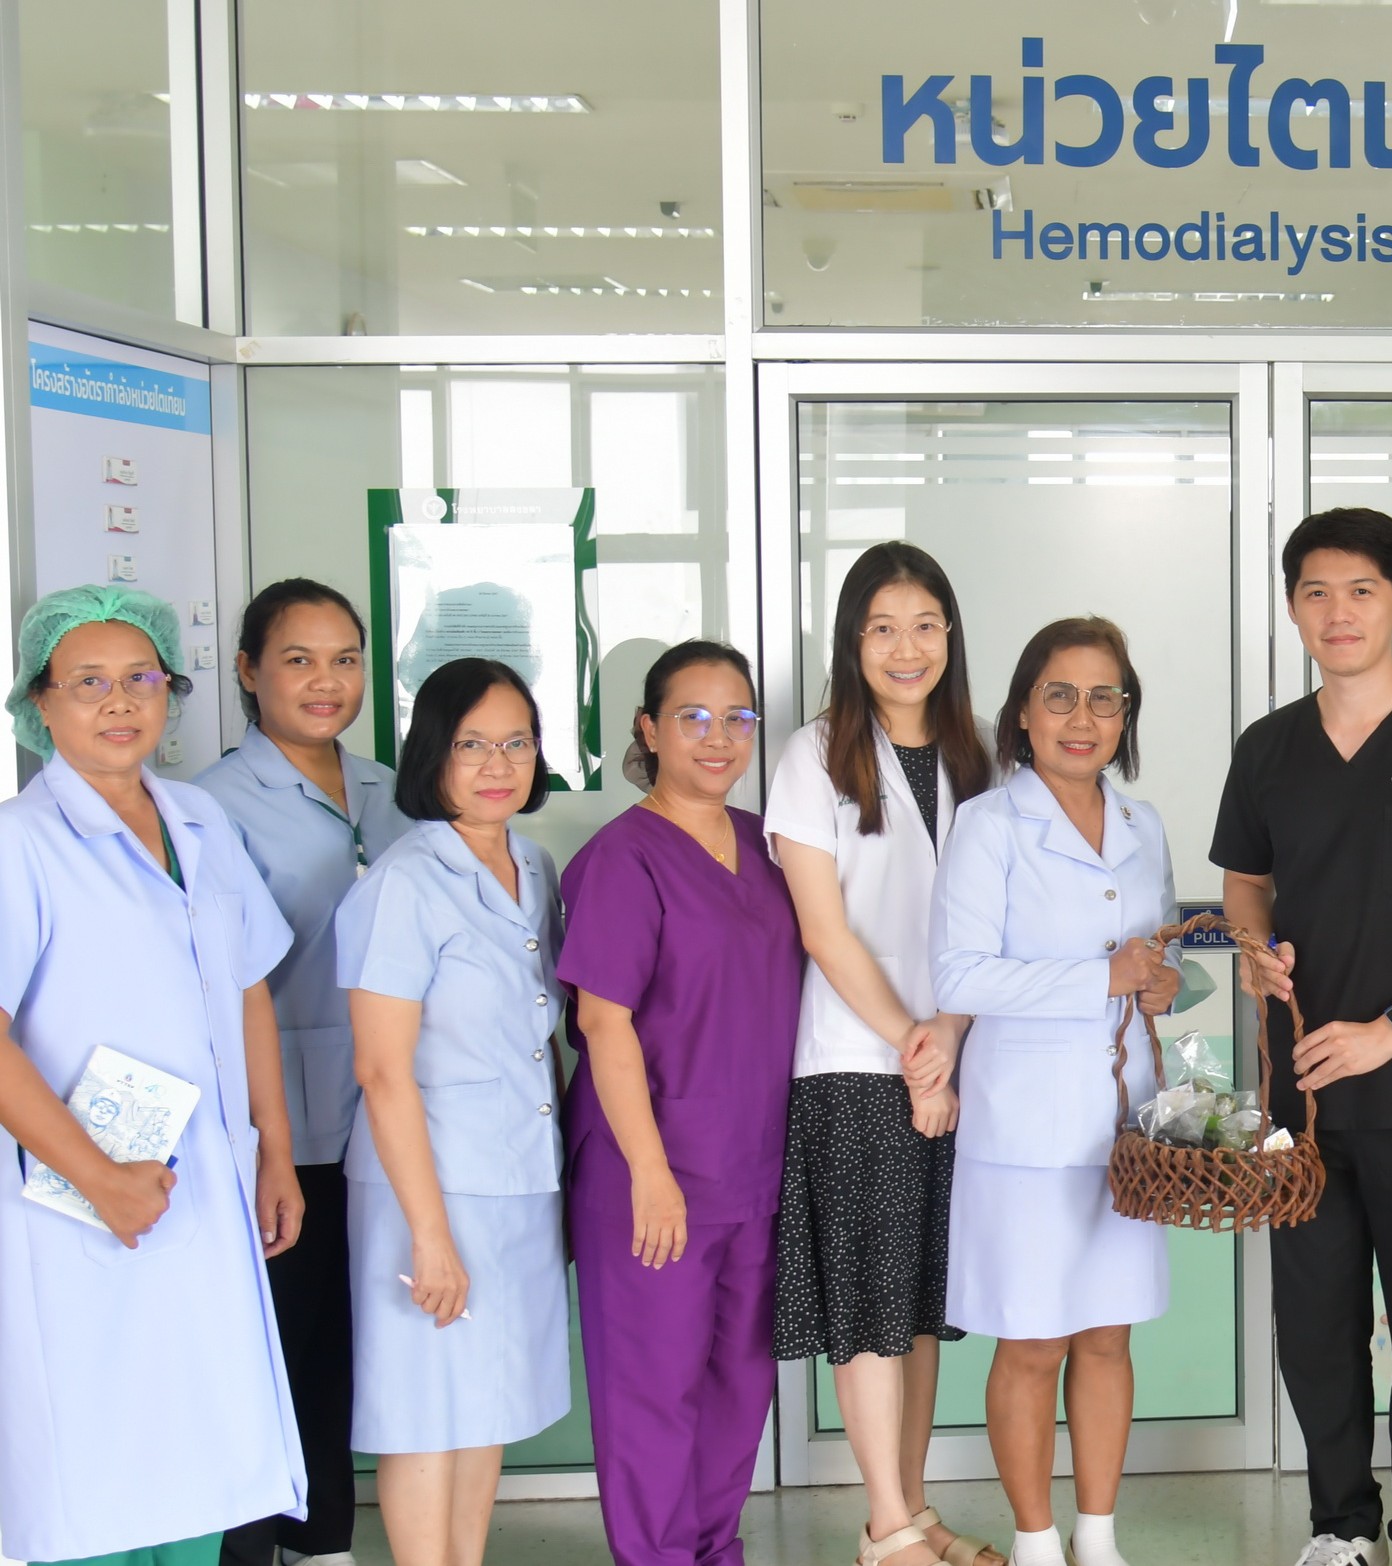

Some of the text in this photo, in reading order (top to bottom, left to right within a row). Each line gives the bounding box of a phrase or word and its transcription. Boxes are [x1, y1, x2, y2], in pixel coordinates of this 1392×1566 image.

[30, 358, 186, 417] โครงสร้างอัตรากำลังหน่วยไตเทียม
[1194, 933, 1228, 944] PULL
